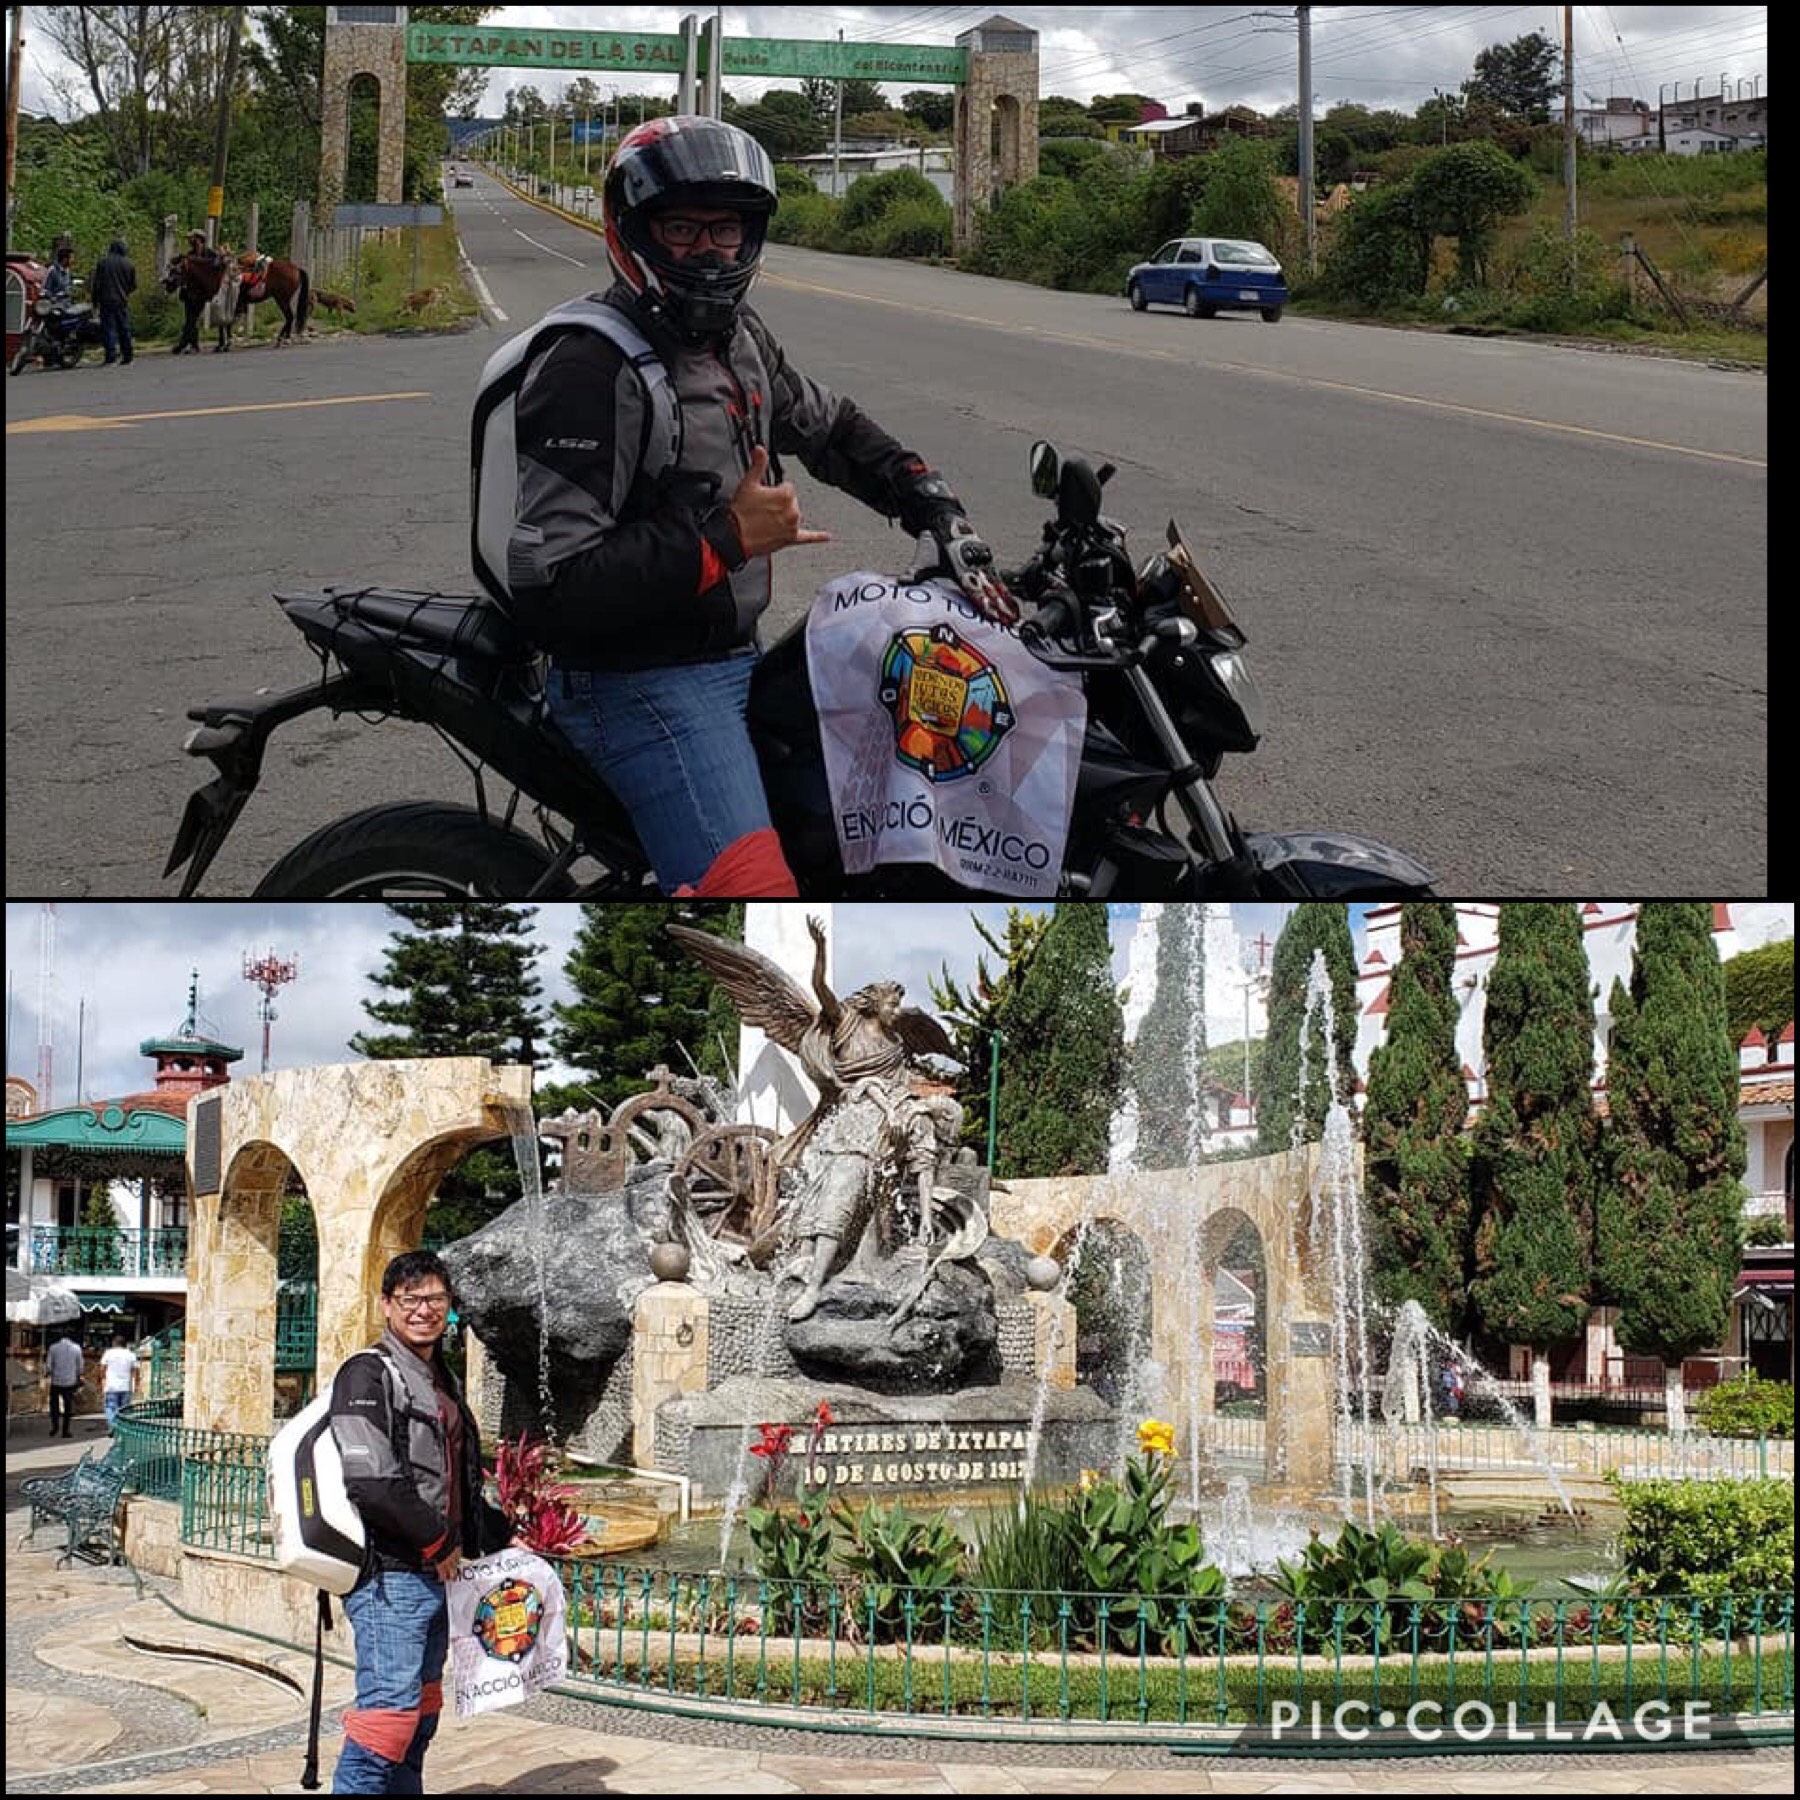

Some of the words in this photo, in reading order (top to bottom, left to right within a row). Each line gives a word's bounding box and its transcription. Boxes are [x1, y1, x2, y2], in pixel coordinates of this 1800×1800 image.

[416, 35, 542, 57] IXTAPAN
[551, 41, 582, 59] DE
[591, 41, 625, 61] LA
[632, 43, 679, 63] SAL
[834, 582, 931, 612] MOTO
[842, 811, 877, 840] EN
[939, 816, 1049, 869] MÉXICO
[914, 1432, 942, 1450] DE
[804, 1465, 827, 1484] 10
[835, 1464, 864, 1484] DE
[872, 1463, 948, 1483] AGOSTO
[958, 1462, 984, 1480] DE
